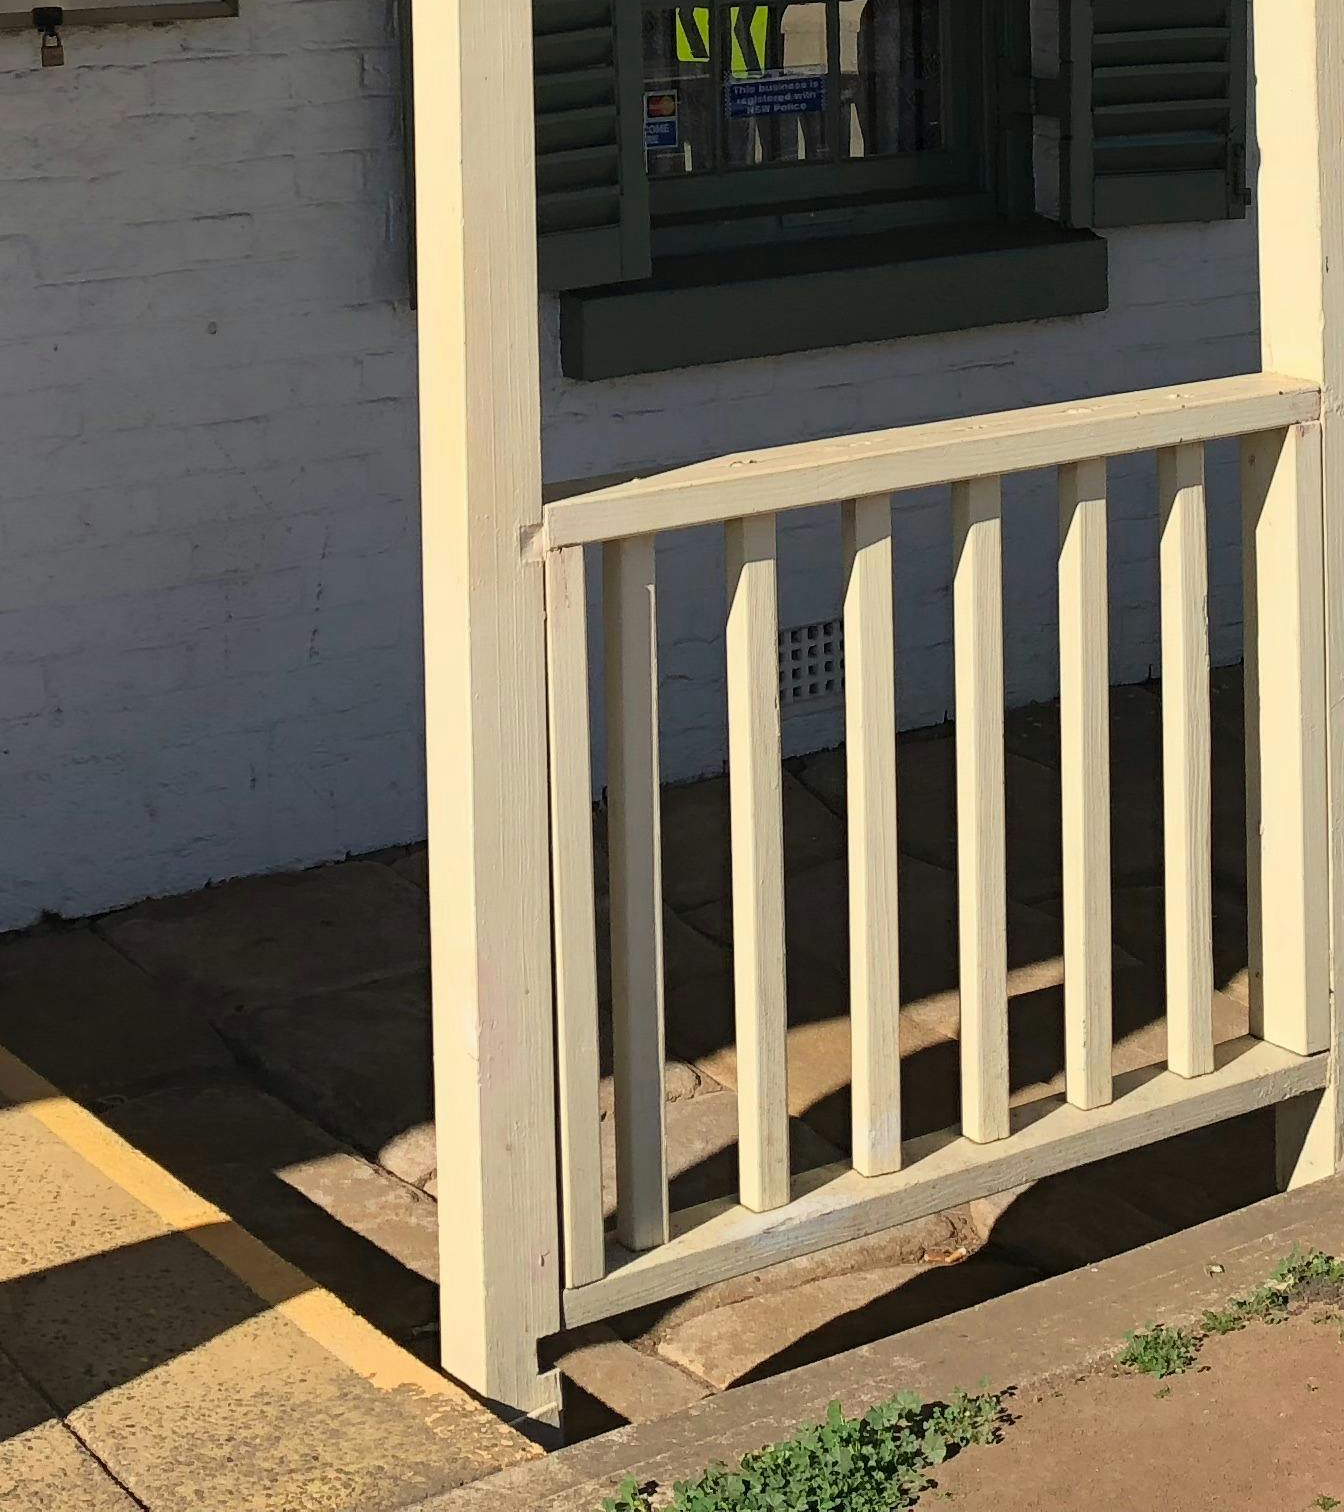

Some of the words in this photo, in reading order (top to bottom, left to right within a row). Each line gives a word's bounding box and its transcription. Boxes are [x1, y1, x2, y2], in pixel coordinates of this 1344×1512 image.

[733, 85, 756, 95] This
[758, 81, 805, 93] business
[809, 80, 819, 88] is
[736, 92, 792, 106] registered
[793, 90, 817, 100] with
[746, 104, 771, 115] NSW
[773, 102, 808, 113] Police
